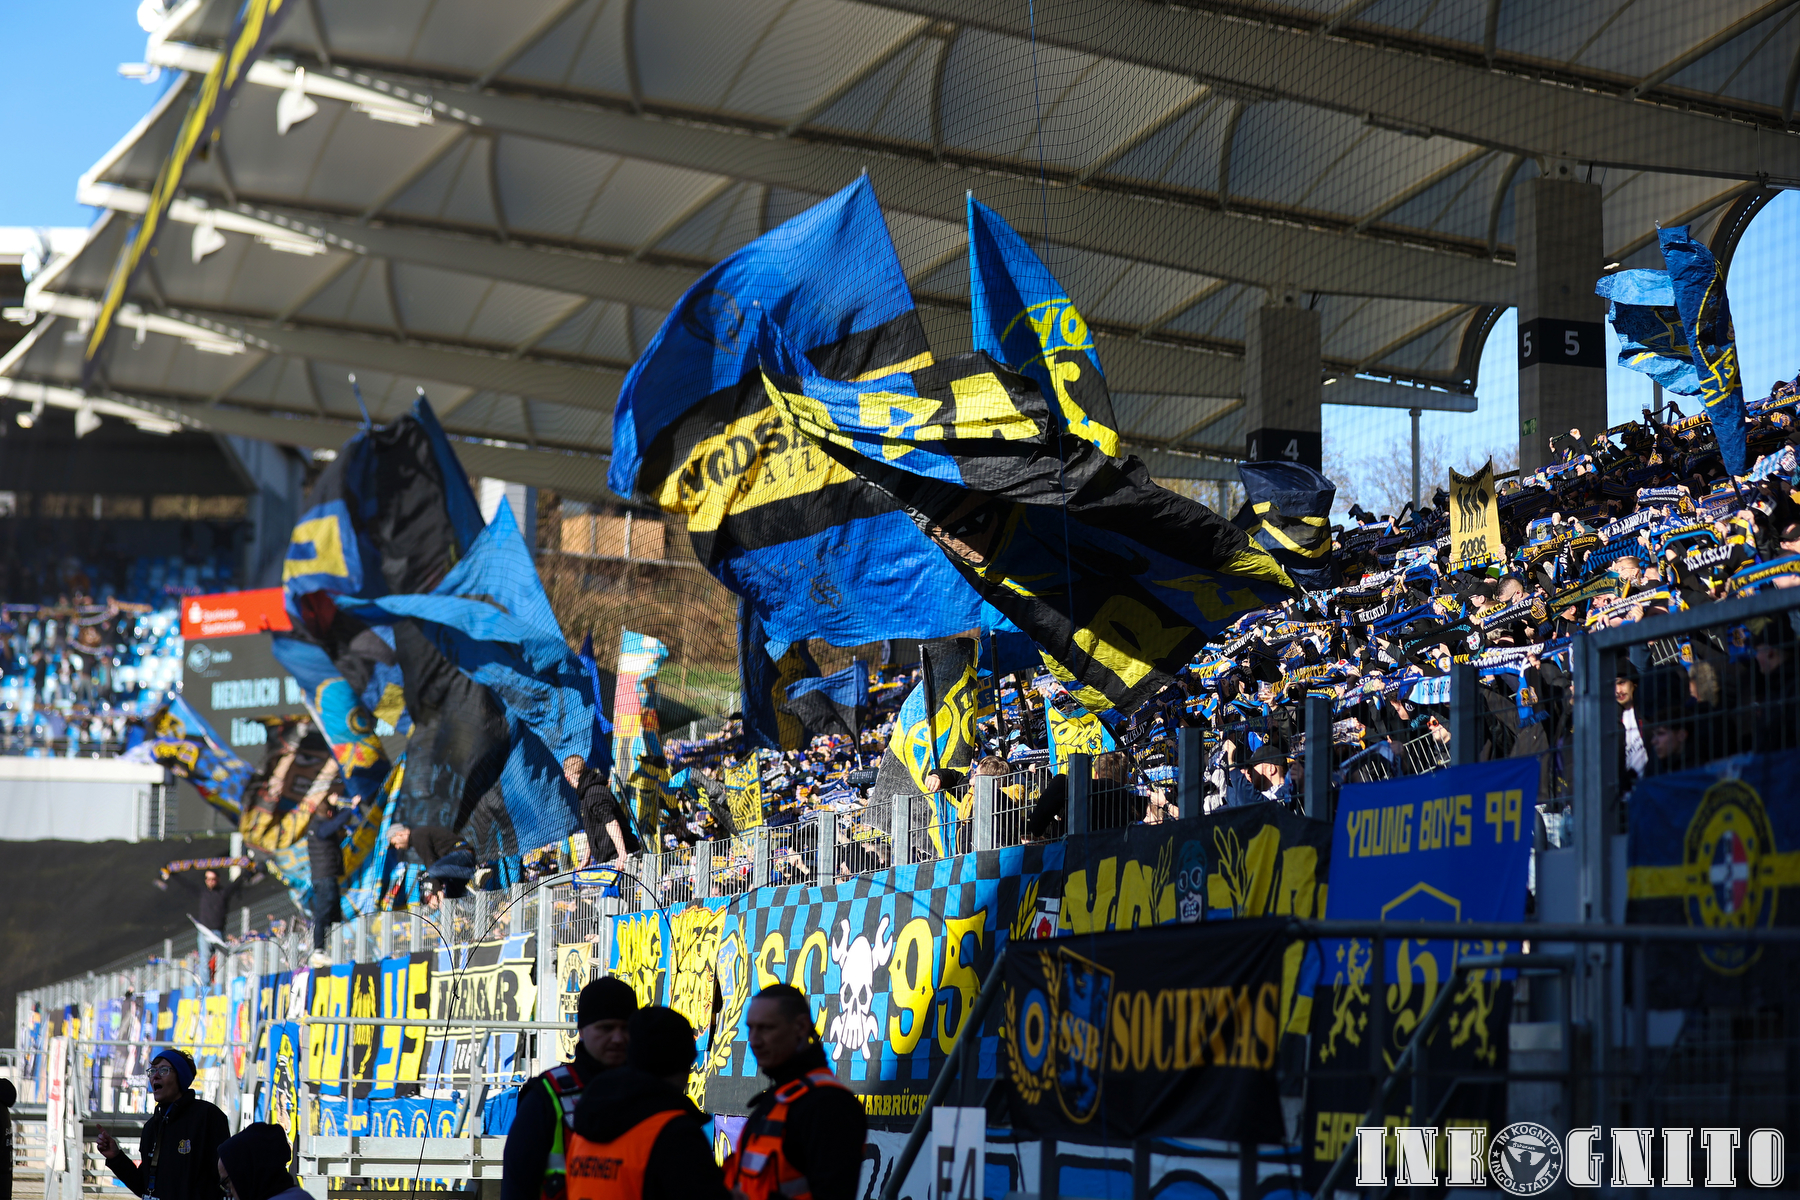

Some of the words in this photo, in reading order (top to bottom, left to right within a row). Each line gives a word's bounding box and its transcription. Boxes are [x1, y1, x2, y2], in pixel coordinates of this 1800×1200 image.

[1523, 330, 1532, 358] 5
[1564, 330, 1580, 356] 5
[1249, 438, 1258, 461] 4
[1283, 438, 1300, 461] 4
[1459, 534, 1488, 559] 2006
[1346, 803, 1414, 858] YOUNG
[1418, 794, 1473, 851] BOYS
[1485, 788, 1523, 844] 99
[888, 912, 987, 1055] 95
[1058, 1009, 1100, 1070] SSB
[1111, 983, 1280, 1073] SOCIETAS
